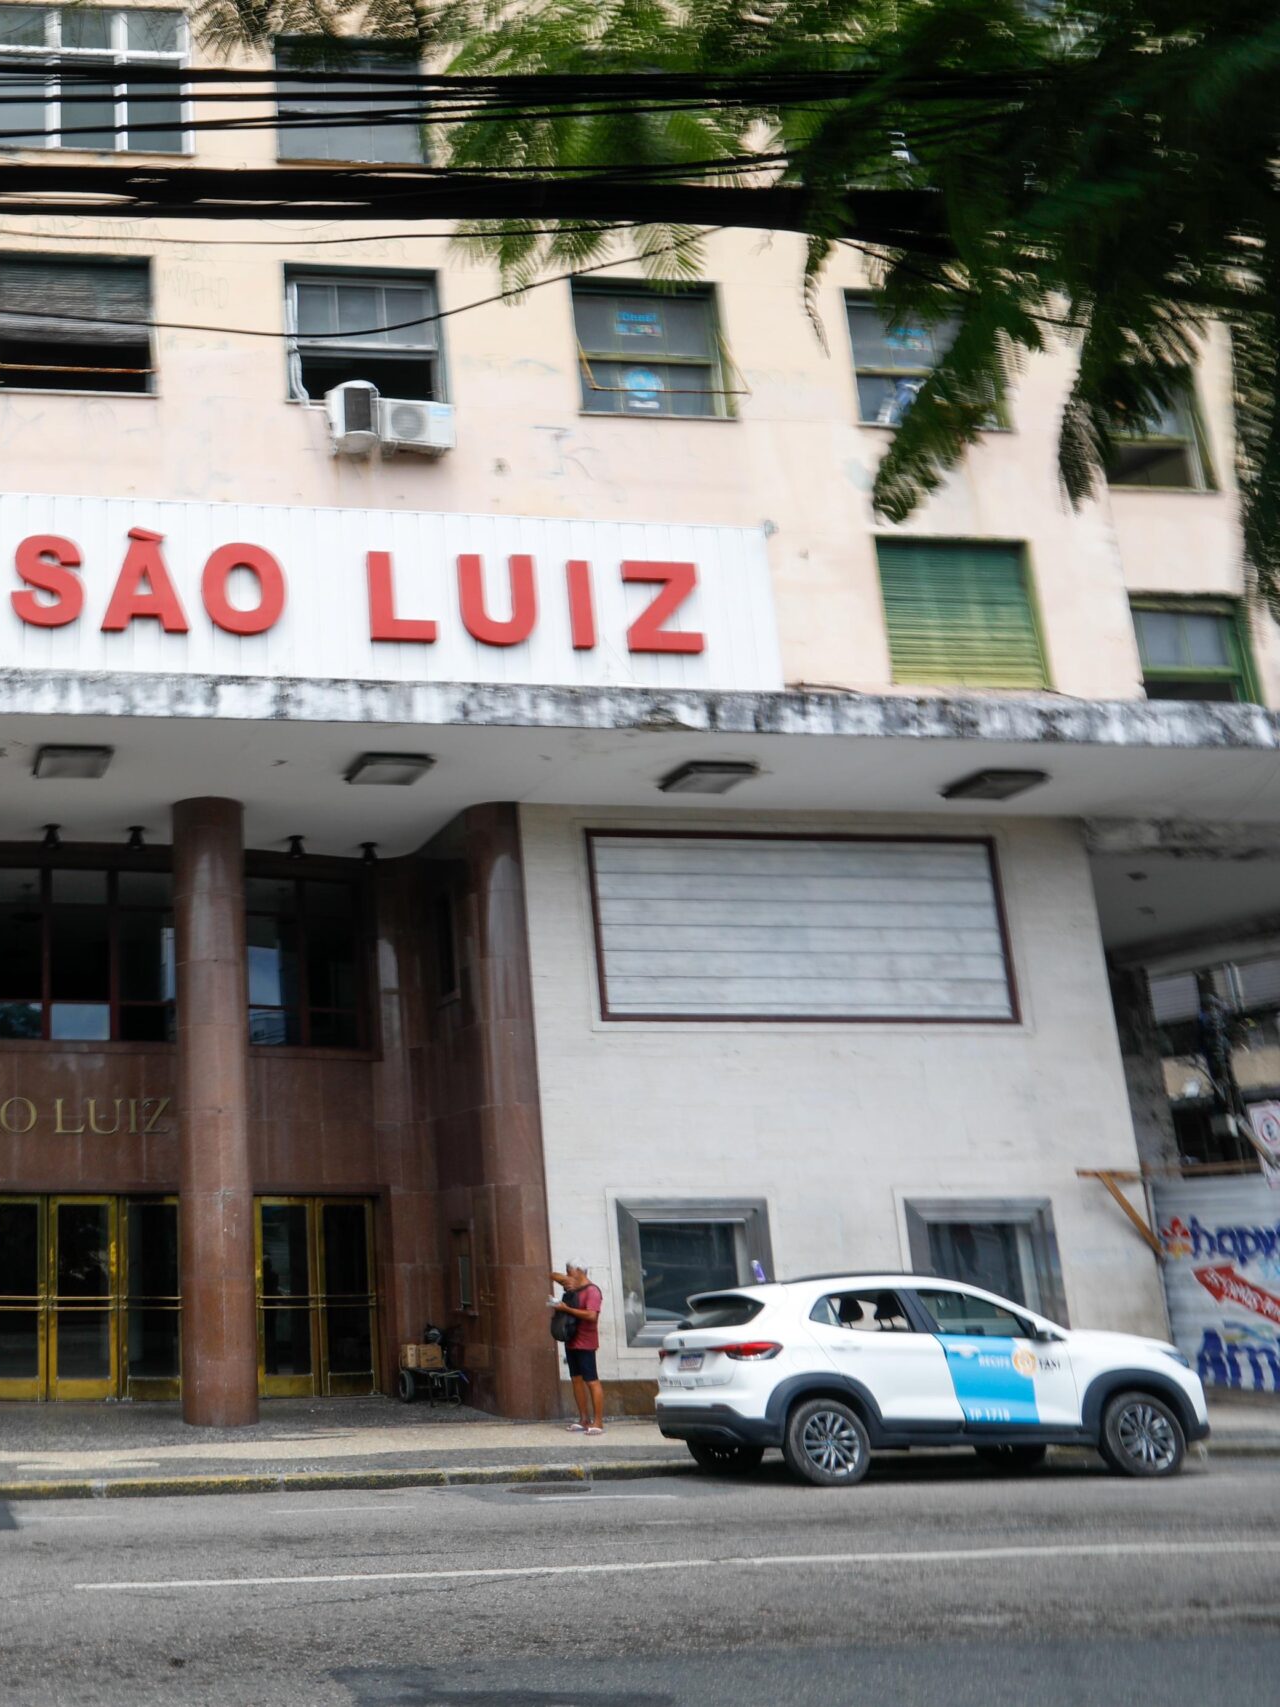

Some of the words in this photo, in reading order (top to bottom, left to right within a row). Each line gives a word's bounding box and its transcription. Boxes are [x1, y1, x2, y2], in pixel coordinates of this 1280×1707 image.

[10, 526, 288, 637] SÃO
[365, 550, 706, 653] LUIZ
[54, 1097, 171, 1135] LUIZ
